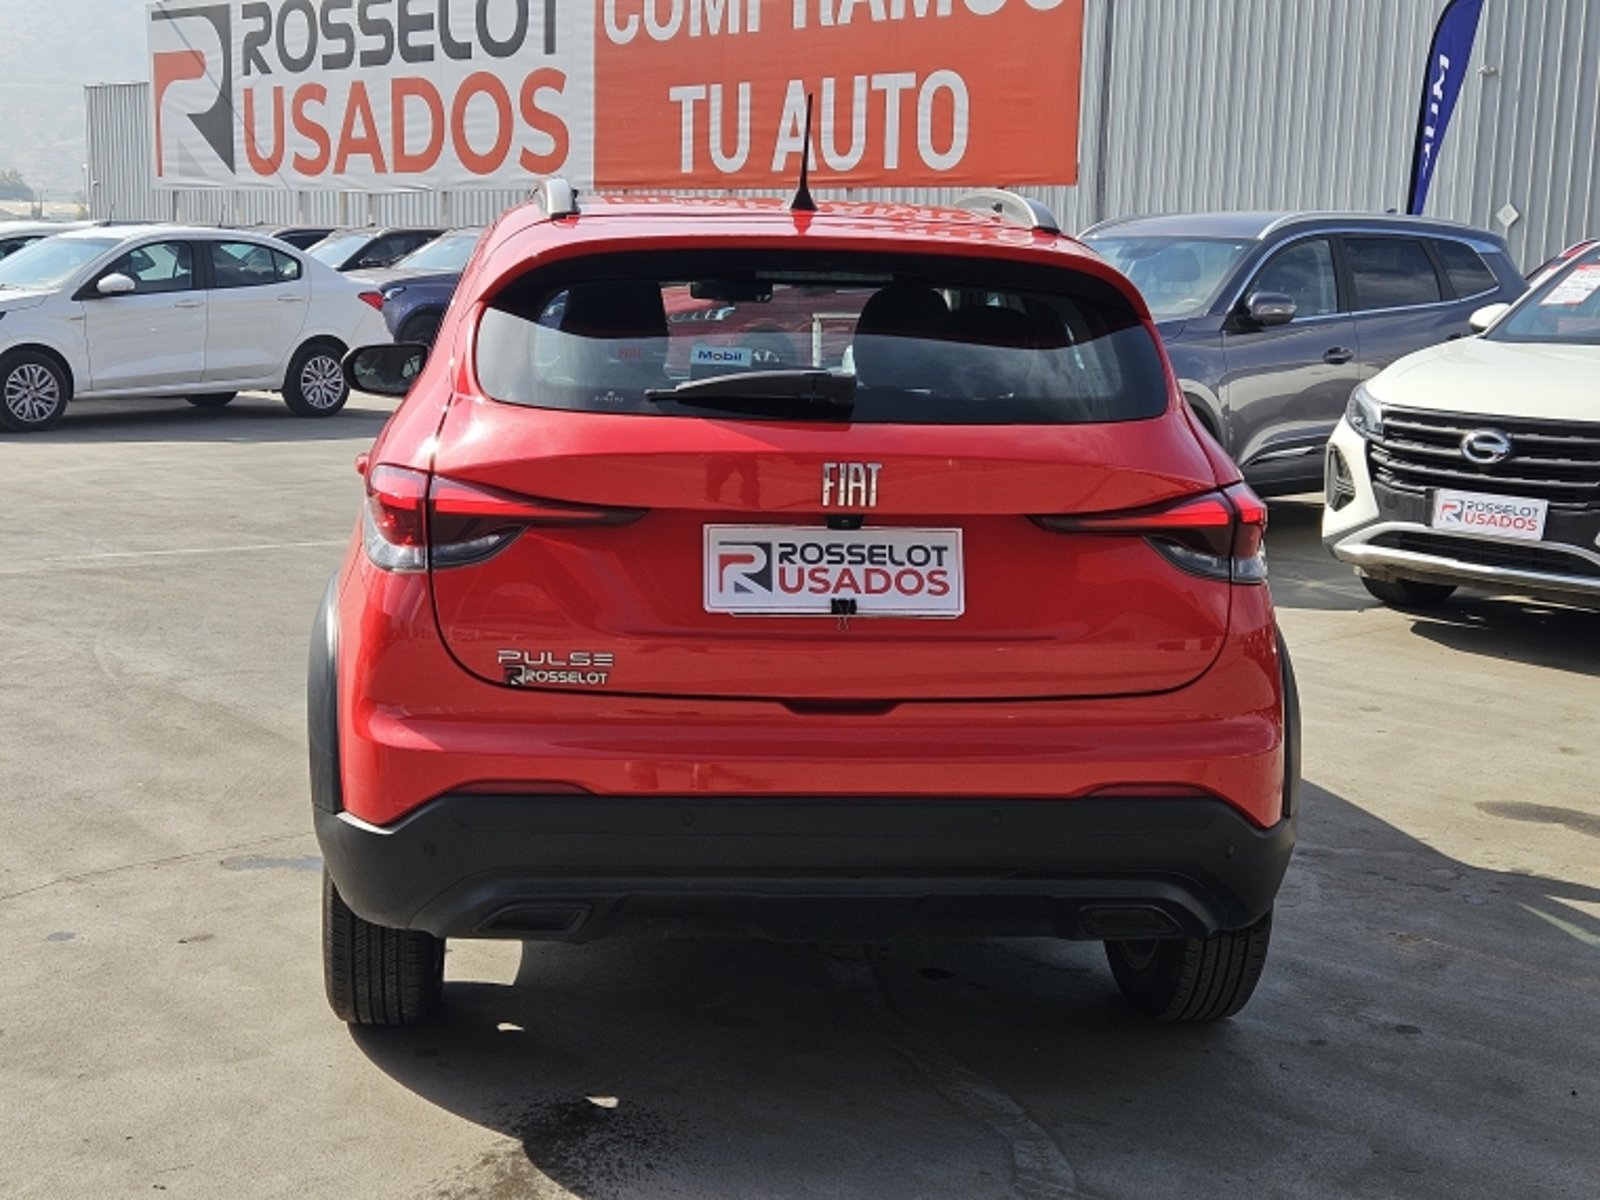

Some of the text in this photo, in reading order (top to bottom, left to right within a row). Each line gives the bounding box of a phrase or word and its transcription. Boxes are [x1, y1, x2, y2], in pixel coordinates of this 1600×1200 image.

[243, 67, 570, 176] USADOS
[669, 69, 969, 174] TU AUTO
[698, 350, 742, 362] Mobil
[821, 462, 882, 507] FIAT
[1466, 501, 1539, 517] ROSSELOT
[1464, 512, 1537, 531] USADOS
[778, 542, 948, 567] ROSSELOT
[778, 567, 950, 596] USADOS
[497, 650, 613, 666] PULSE
[526, 670, 607, 684] ROSSELOT
